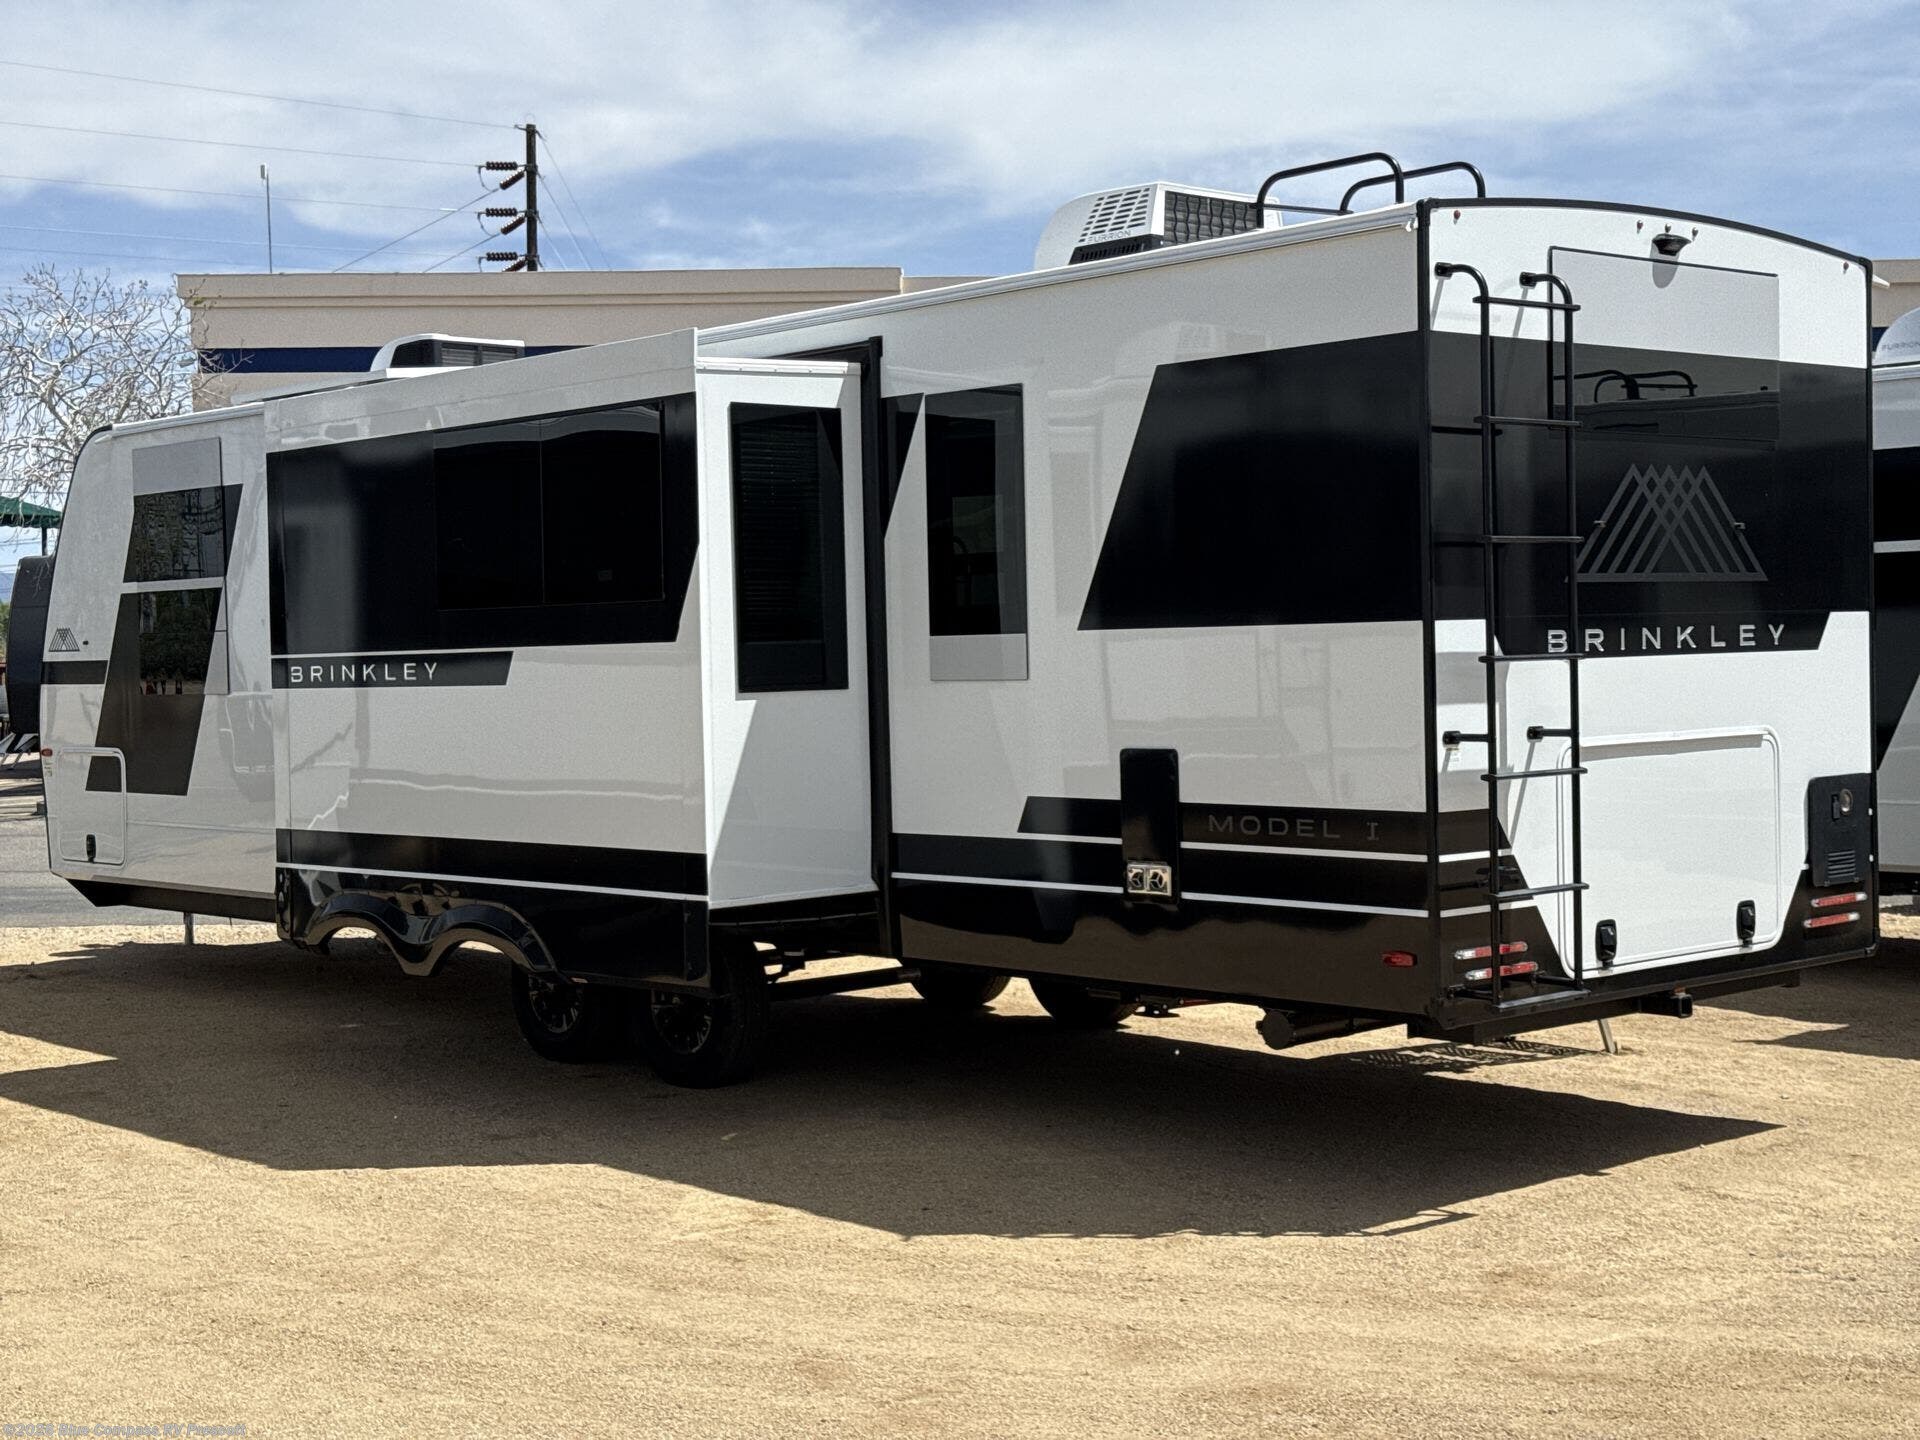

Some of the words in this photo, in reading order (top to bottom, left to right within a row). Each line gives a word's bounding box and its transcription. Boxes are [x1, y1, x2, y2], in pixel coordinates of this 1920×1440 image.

[1547, 624, 1785, 653] BRINKLEY
[290, 662, 437, 683] BRINKLEY
[1208, 814, 1341, 839] MODEL
